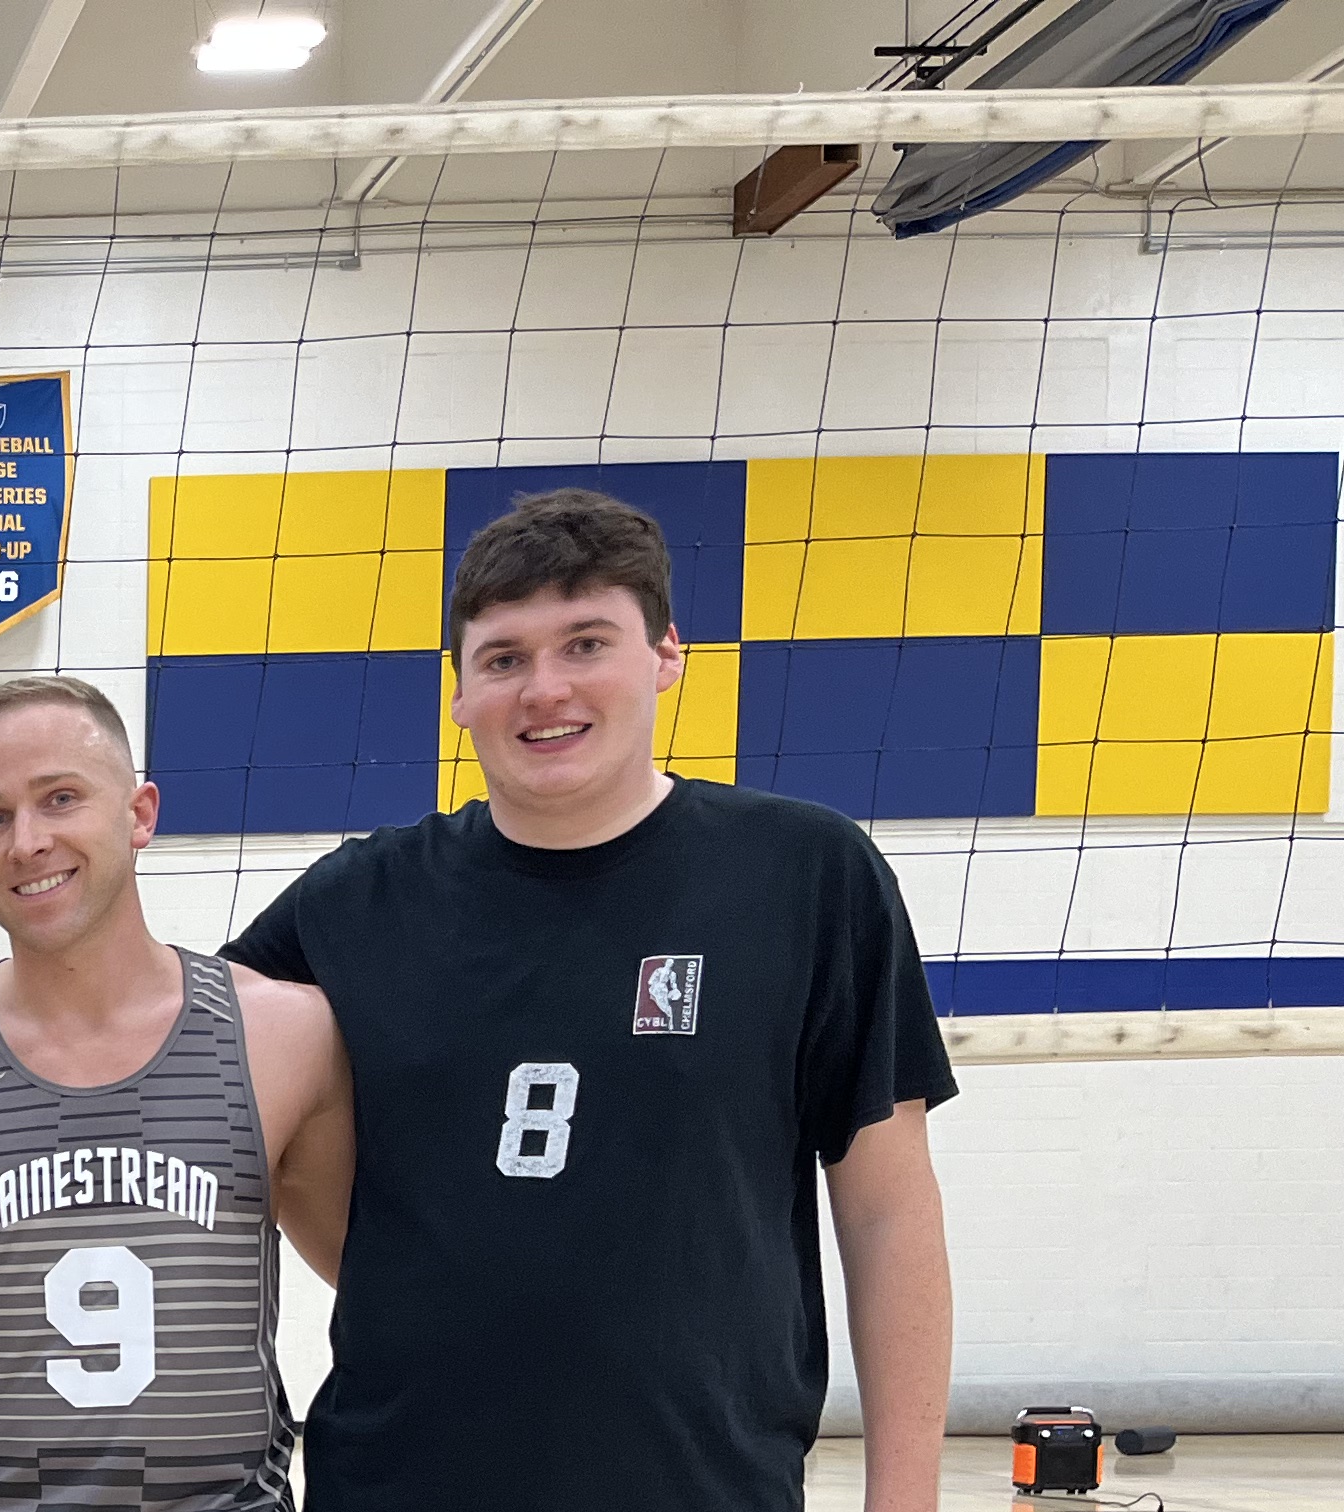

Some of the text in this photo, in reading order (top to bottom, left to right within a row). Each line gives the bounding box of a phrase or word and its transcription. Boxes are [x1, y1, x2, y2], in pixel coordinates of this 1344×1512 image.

[637, 1016, 667, 1028] CYBL
[680, 960, 697, 1030] CHELMSFORD
[496, 1062, 580, 1179] 8
[44, 1245, 156, 1409] 9
